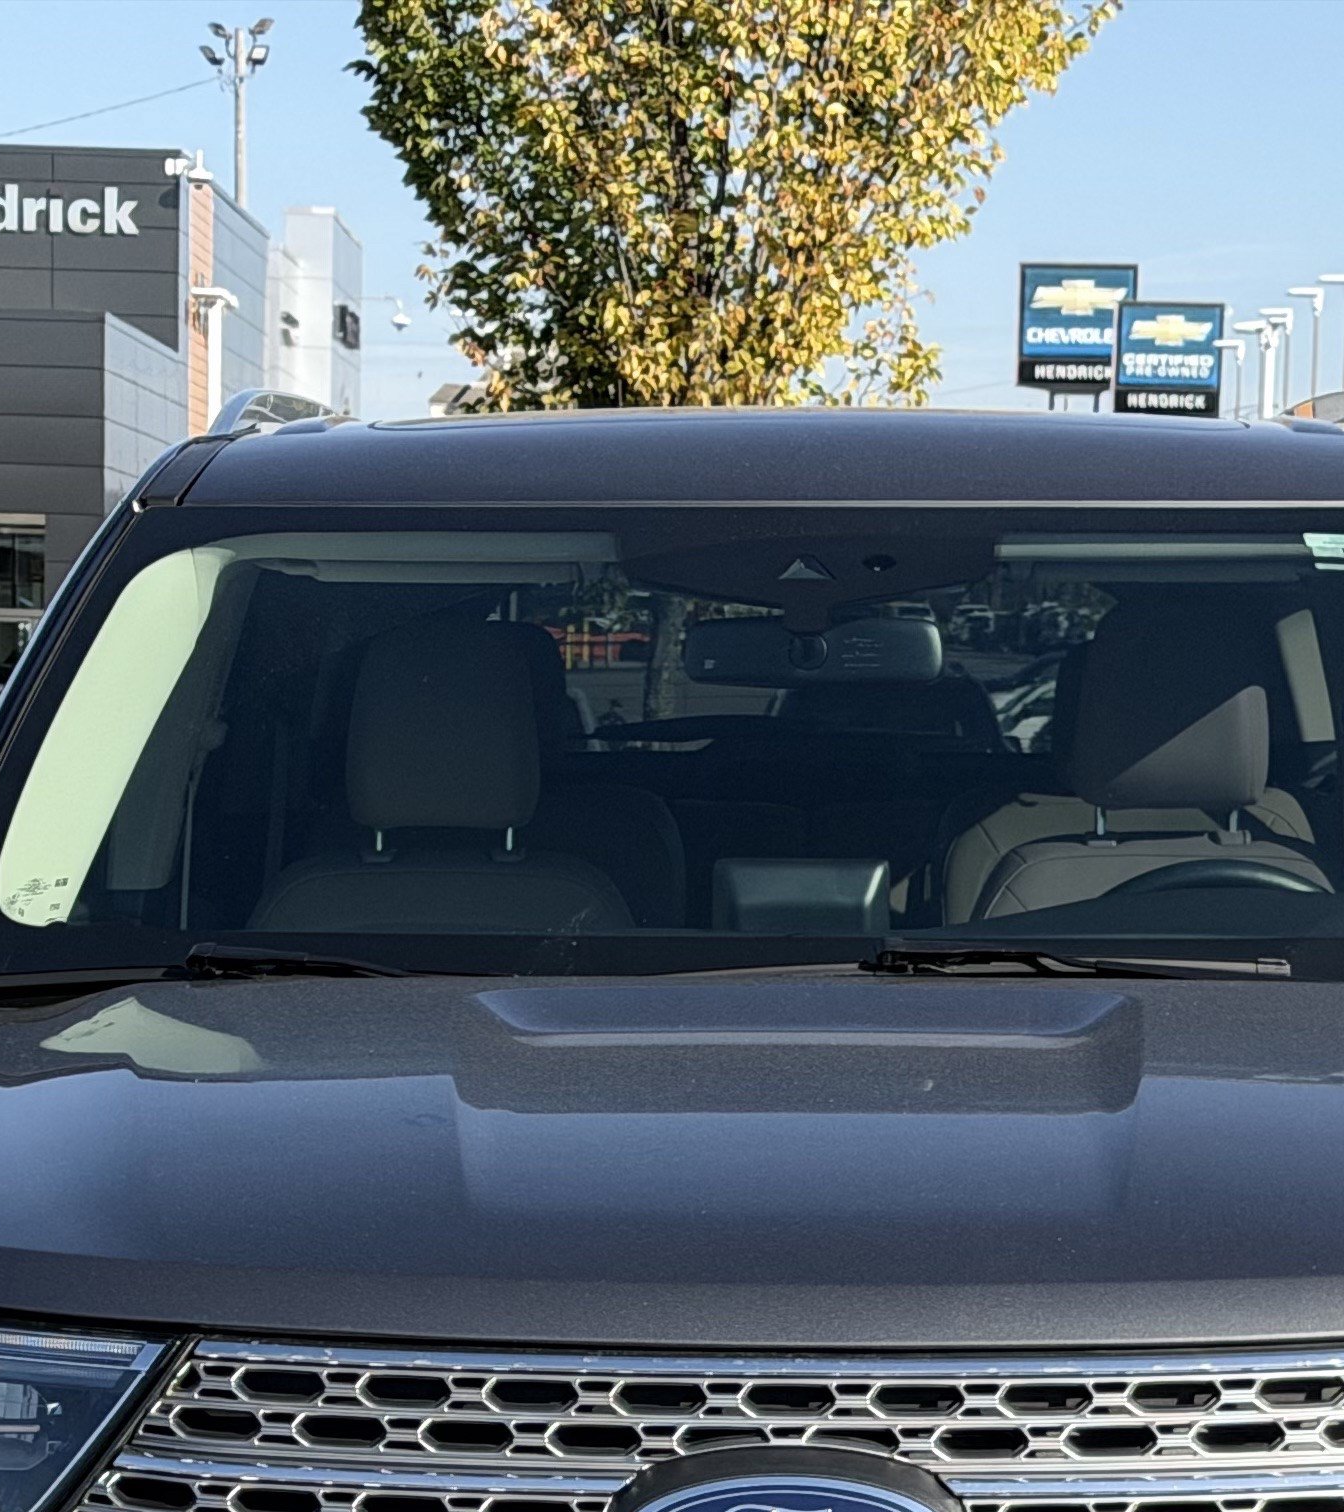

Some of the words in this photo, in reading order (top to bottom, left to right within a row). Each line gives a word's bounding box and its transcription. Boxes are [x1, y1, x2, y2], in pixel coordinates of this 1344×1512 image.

[1026, 326, 1113, 345] CHEVROLE
[1122, 353, 1215, 368] CERTIFIED
[1126, 392, 1206, 411] HENDRICK
